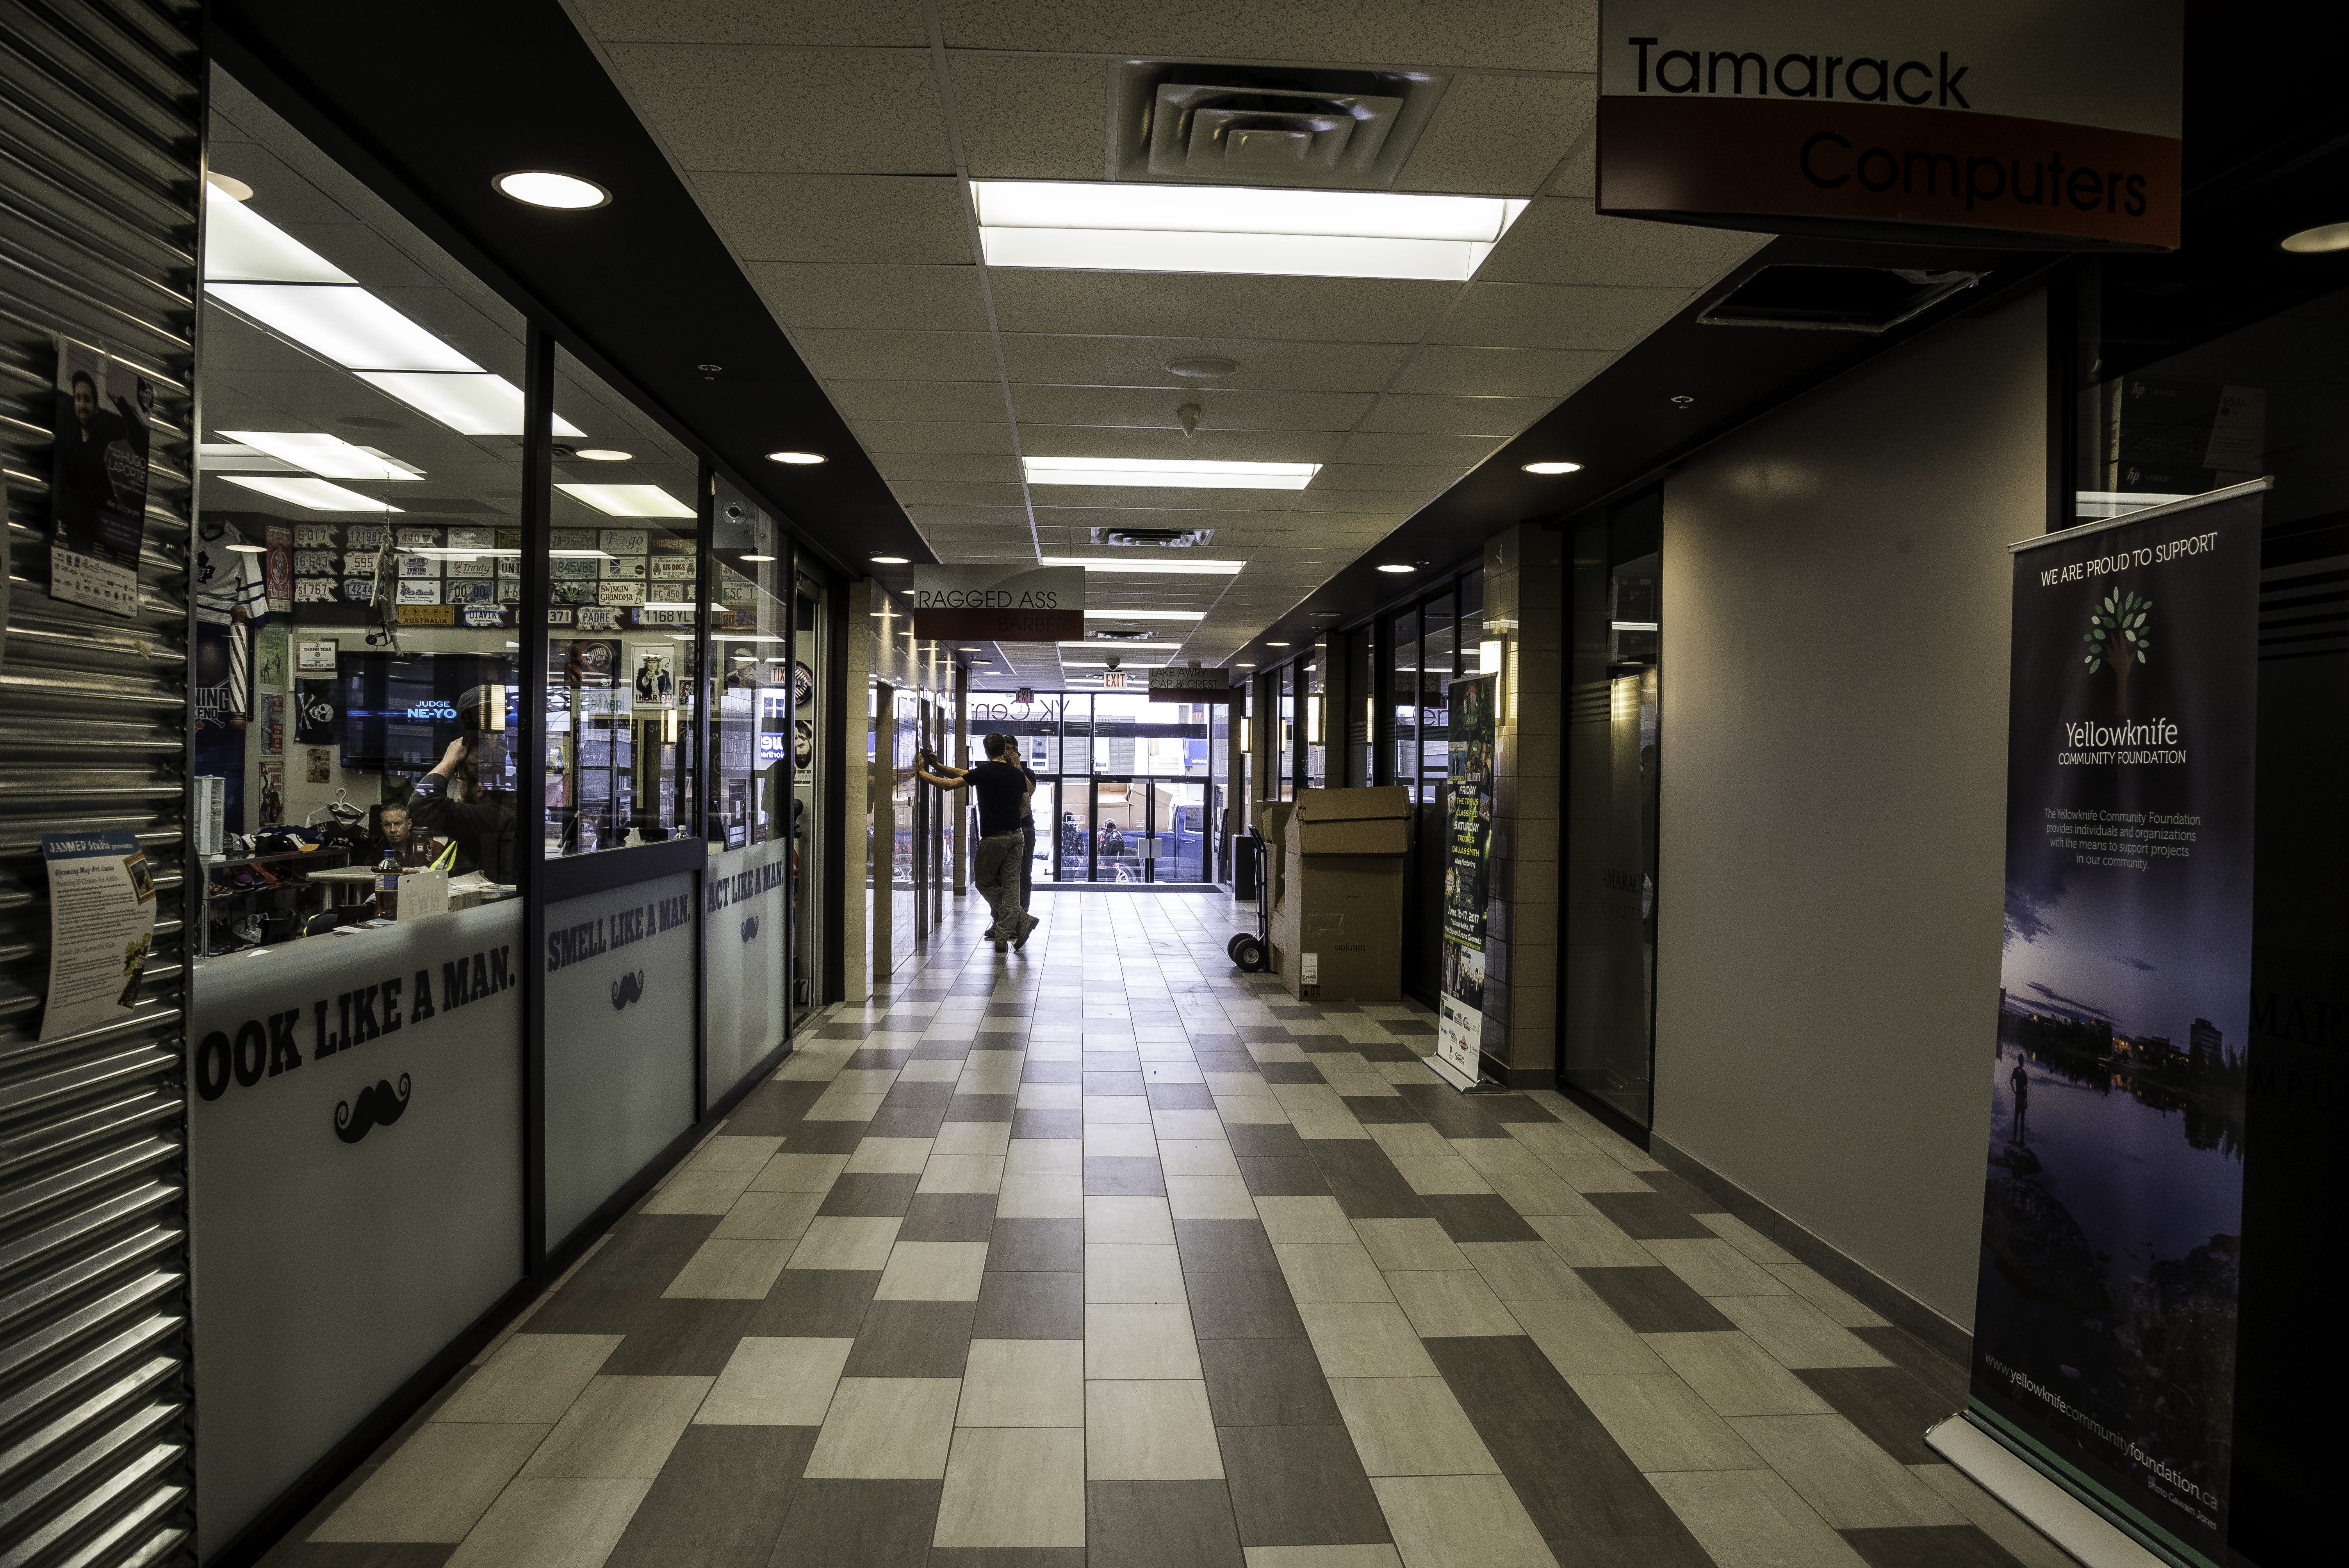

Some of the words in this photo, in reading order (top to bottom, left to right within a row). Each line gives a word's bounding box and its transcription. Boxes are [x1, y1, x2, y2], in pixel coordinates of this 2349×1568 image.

[1629, 37, 1970, 108] Tamarack
[1800, 131, 2146, 217] Computers
[2131, 381, 2145, 399] hp
[2127, 467, 2140, 485] hp
[355, 558, 373, 568] 595
[2041, 568, 2058, 587] WE
[2060, 563, 2083, 583] ARE
[2087, 554, 2129, 577] PROUD
[2132, 548, 2152, 567] TO
[2156, 532, 2218, 563] SUPPORT
[464, 563, 490, 574] Trinity
[919, 590, 1012, 608] RAGGED
[1019, 591, 1057, 609] ASS
[470, 610, 497, 619] DIAVIK
[583, 613, 610, 622] PADRE
[1106, 674, 1125, 687] EXIT
[1152, 668, 1174, 677] LAKE
[1178, 668, 1207, 678] AWRY
[1151, 679, 1172, 688] CAP
[1176, 680, 1183, 688] &
[1187, 679, 1217, 689] CREST
[1017, 691, 1033, 702] EXIT
[407, 708, 457, 718] NE-YO
[2066, 718, 2178, 747] Yellowknife
[2058, 752, 2115, 765] COMMUNITY
[2117, 750, 2186, 764] FOUNDATION
[1460, 786, 1477, 795] FRIDAY
[1465, 798, 1479, 806] TREWS
[1456, 809, 1478, 818] CLASSIFIED
[2044, 808, 2055, 819] The
[2057, 809, 2097, 821] Yellowknife
[2099, 810, 2146, 825] Community
[2149, 812, 2201, 825] Foundation
[1454, 821, 1479, 832] SATURDAY
[2046, 823, 2073, 835] provides
[2075, 824, 2118, 837] individuals
[2120, 827, 2133, 837] and
[2135, 828, 2196, 841] organizations
[88, 839, 110, 850] Studio
[1457, 834, 1475, 844] TROOPER
[1452, 845, 1467, 855] DALLAS
[1467, 848, 1479, 857] SMITH
[2050, 837, 2064, 848] with
[2066, 838, 2077, 848] the
[2079, 840, 2107, 851] means
[2109, 841, 2117, 851] to
[2119, 842, 2148, 855] support
[2151, 844, 2190, 858] projects
[2076, 853, 2084, 864] in
[2086, 855, 2100, 865] our
[2103, 856, 2149, 872] community.
[708, 877, 730, 913] ACT
[732, 870, 754, 904] LIKE
[754, 868, 762, 895] A
[763, 860, 784, 893] MAN.
[1448, 905, 1457, 917] June
[1469, 912, 1479, 924] 2017
[548, 918, 606, 972] SMELL
[610, 907, 643, 950] LIKE
[646, 903, 656, 937] A
[659, 894, 690, 933] MAN.
[1458, 930, 1467, 939] Arena
[1468, 934, 1481, 945] Grounds
[315, 977, 402, 1060] LIKE
[411, 969, 435, 1024] A
[443, 945, 515, 1012] MAN.
[1985, 1352, 2218, 1512] www.yellowknifecommunityfoundation.ca
